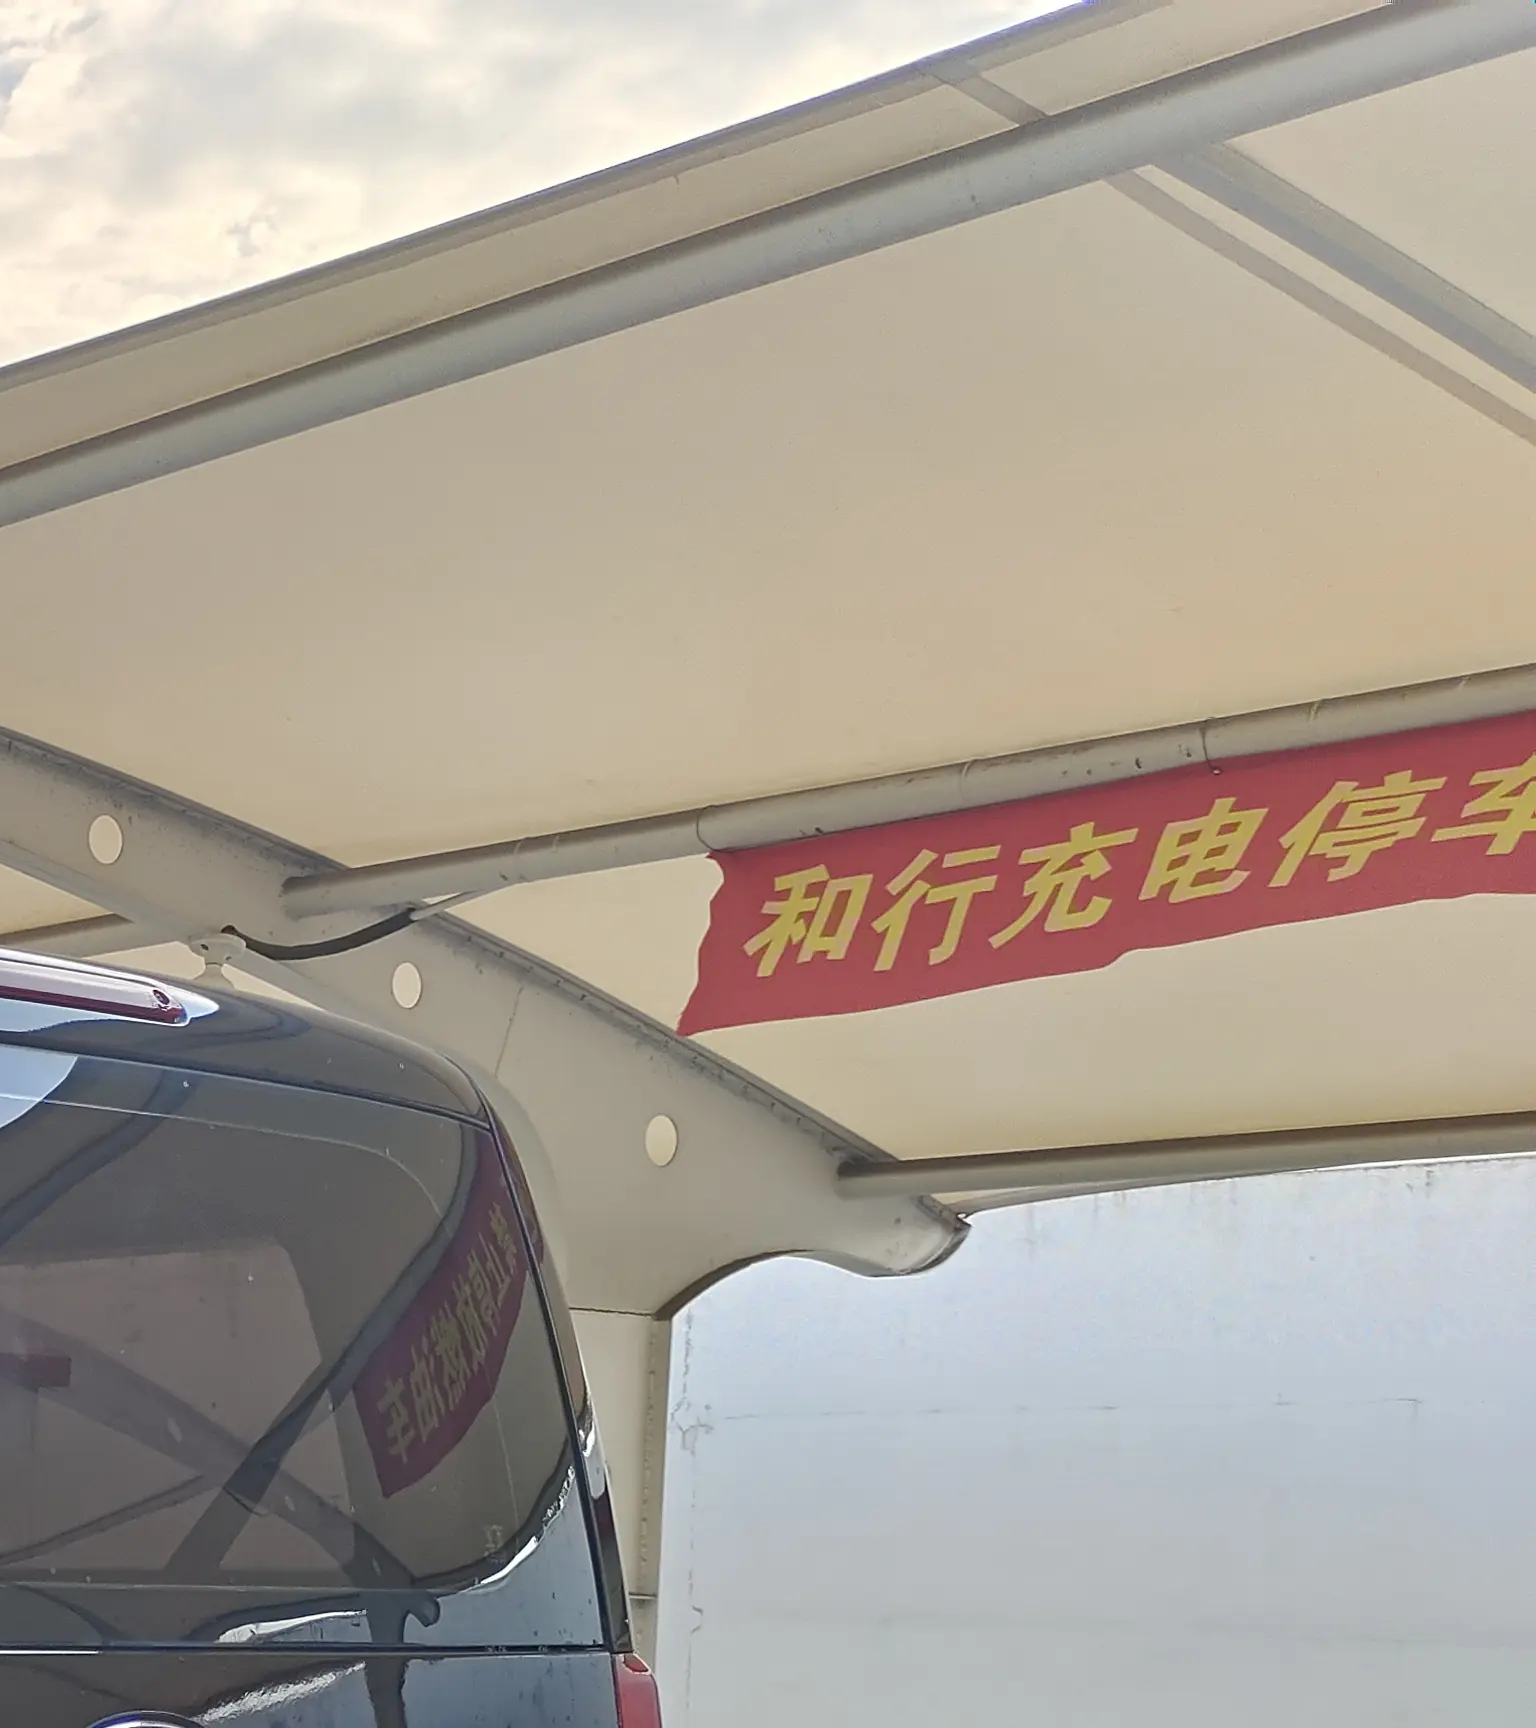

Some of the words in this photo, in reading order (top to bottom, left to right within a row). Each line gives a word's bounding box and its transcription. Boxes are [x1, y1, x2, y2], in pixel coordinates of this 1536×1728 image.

[743, 752, 1536, 977] 和行充电停车
